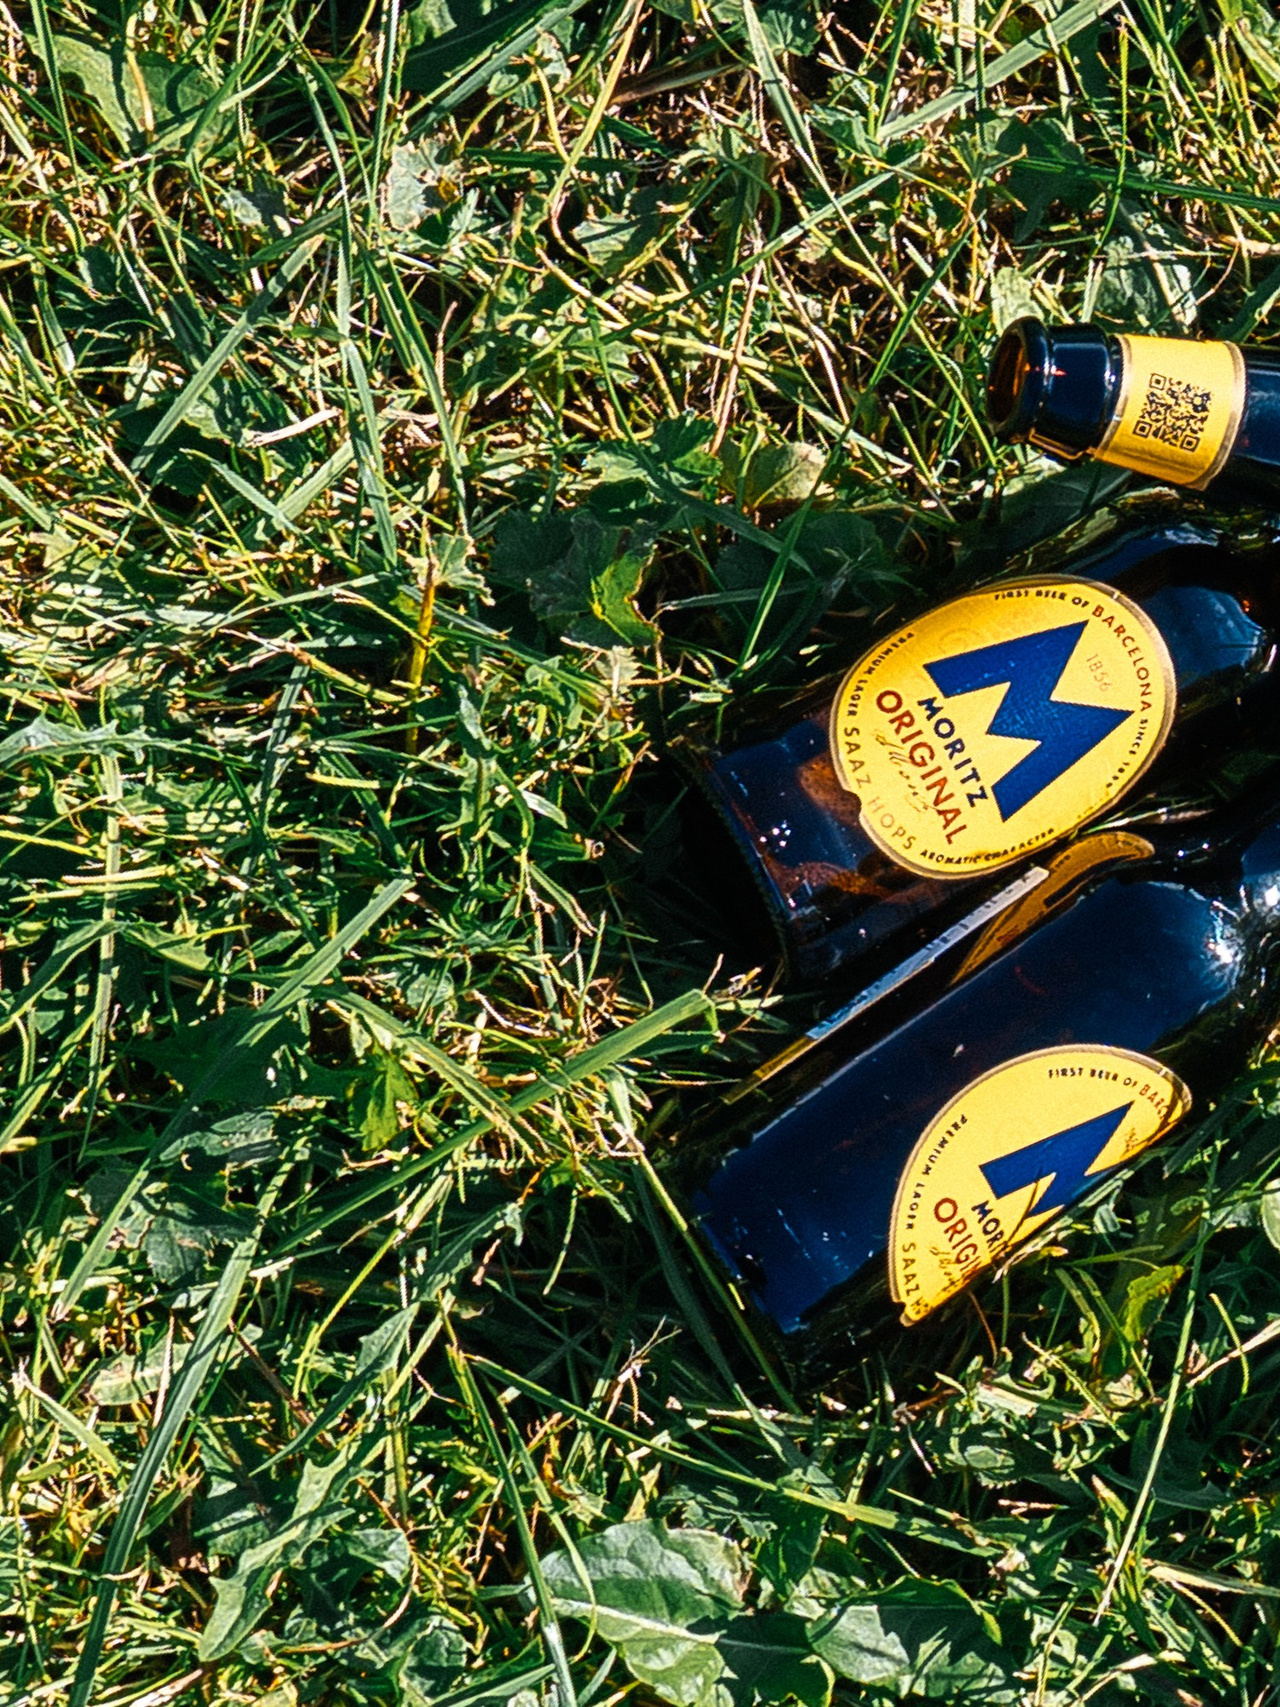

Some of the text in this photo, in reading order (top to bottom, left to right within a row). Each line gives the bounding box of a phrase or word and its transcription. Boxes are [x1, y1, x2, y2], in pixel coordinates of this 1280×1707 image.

[994, 589, 1029, 600] FIRST
[1071, 596, 1090, 608] OF
[1092, 604, 1152, 712] BARCELONA
[1086, 653, 1112, 692] 1856
[876, 690, 968, 845] ORIGINAL
[916, 696, 989, 808] MORITZ
[844, 727, 872, 789] SAAZ
[868, 796, 916, 850] HOPS
[920, 849, 981, 865] AROMATIC
[1048, 1067, 1084, 1079] FIRST
[922, 1113, 968, 1176] PREMIUM
[902, 1242, 920, 1297] SAAZ
